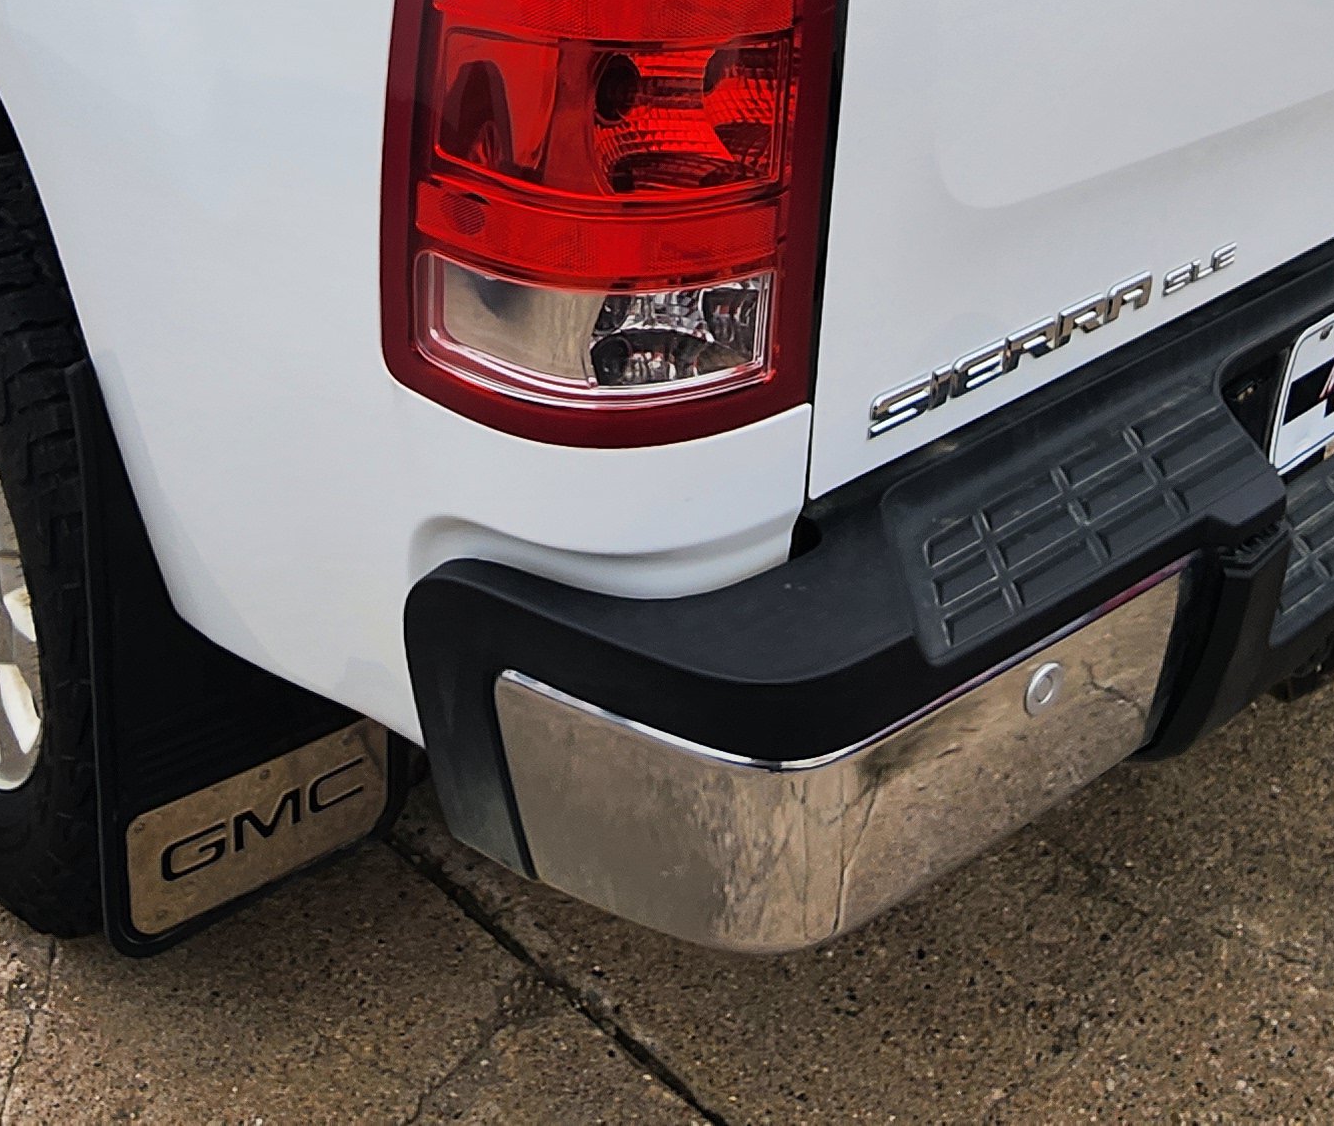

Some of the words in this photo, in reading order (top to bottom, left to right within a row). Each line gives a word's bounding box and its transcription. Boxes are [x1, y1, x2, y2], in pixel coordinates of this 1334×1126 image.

[867, 270, 1153, 440] SIERRA
[1162, 241, 1237, 297] SLE
[161, 755, 365, 882] GMC
